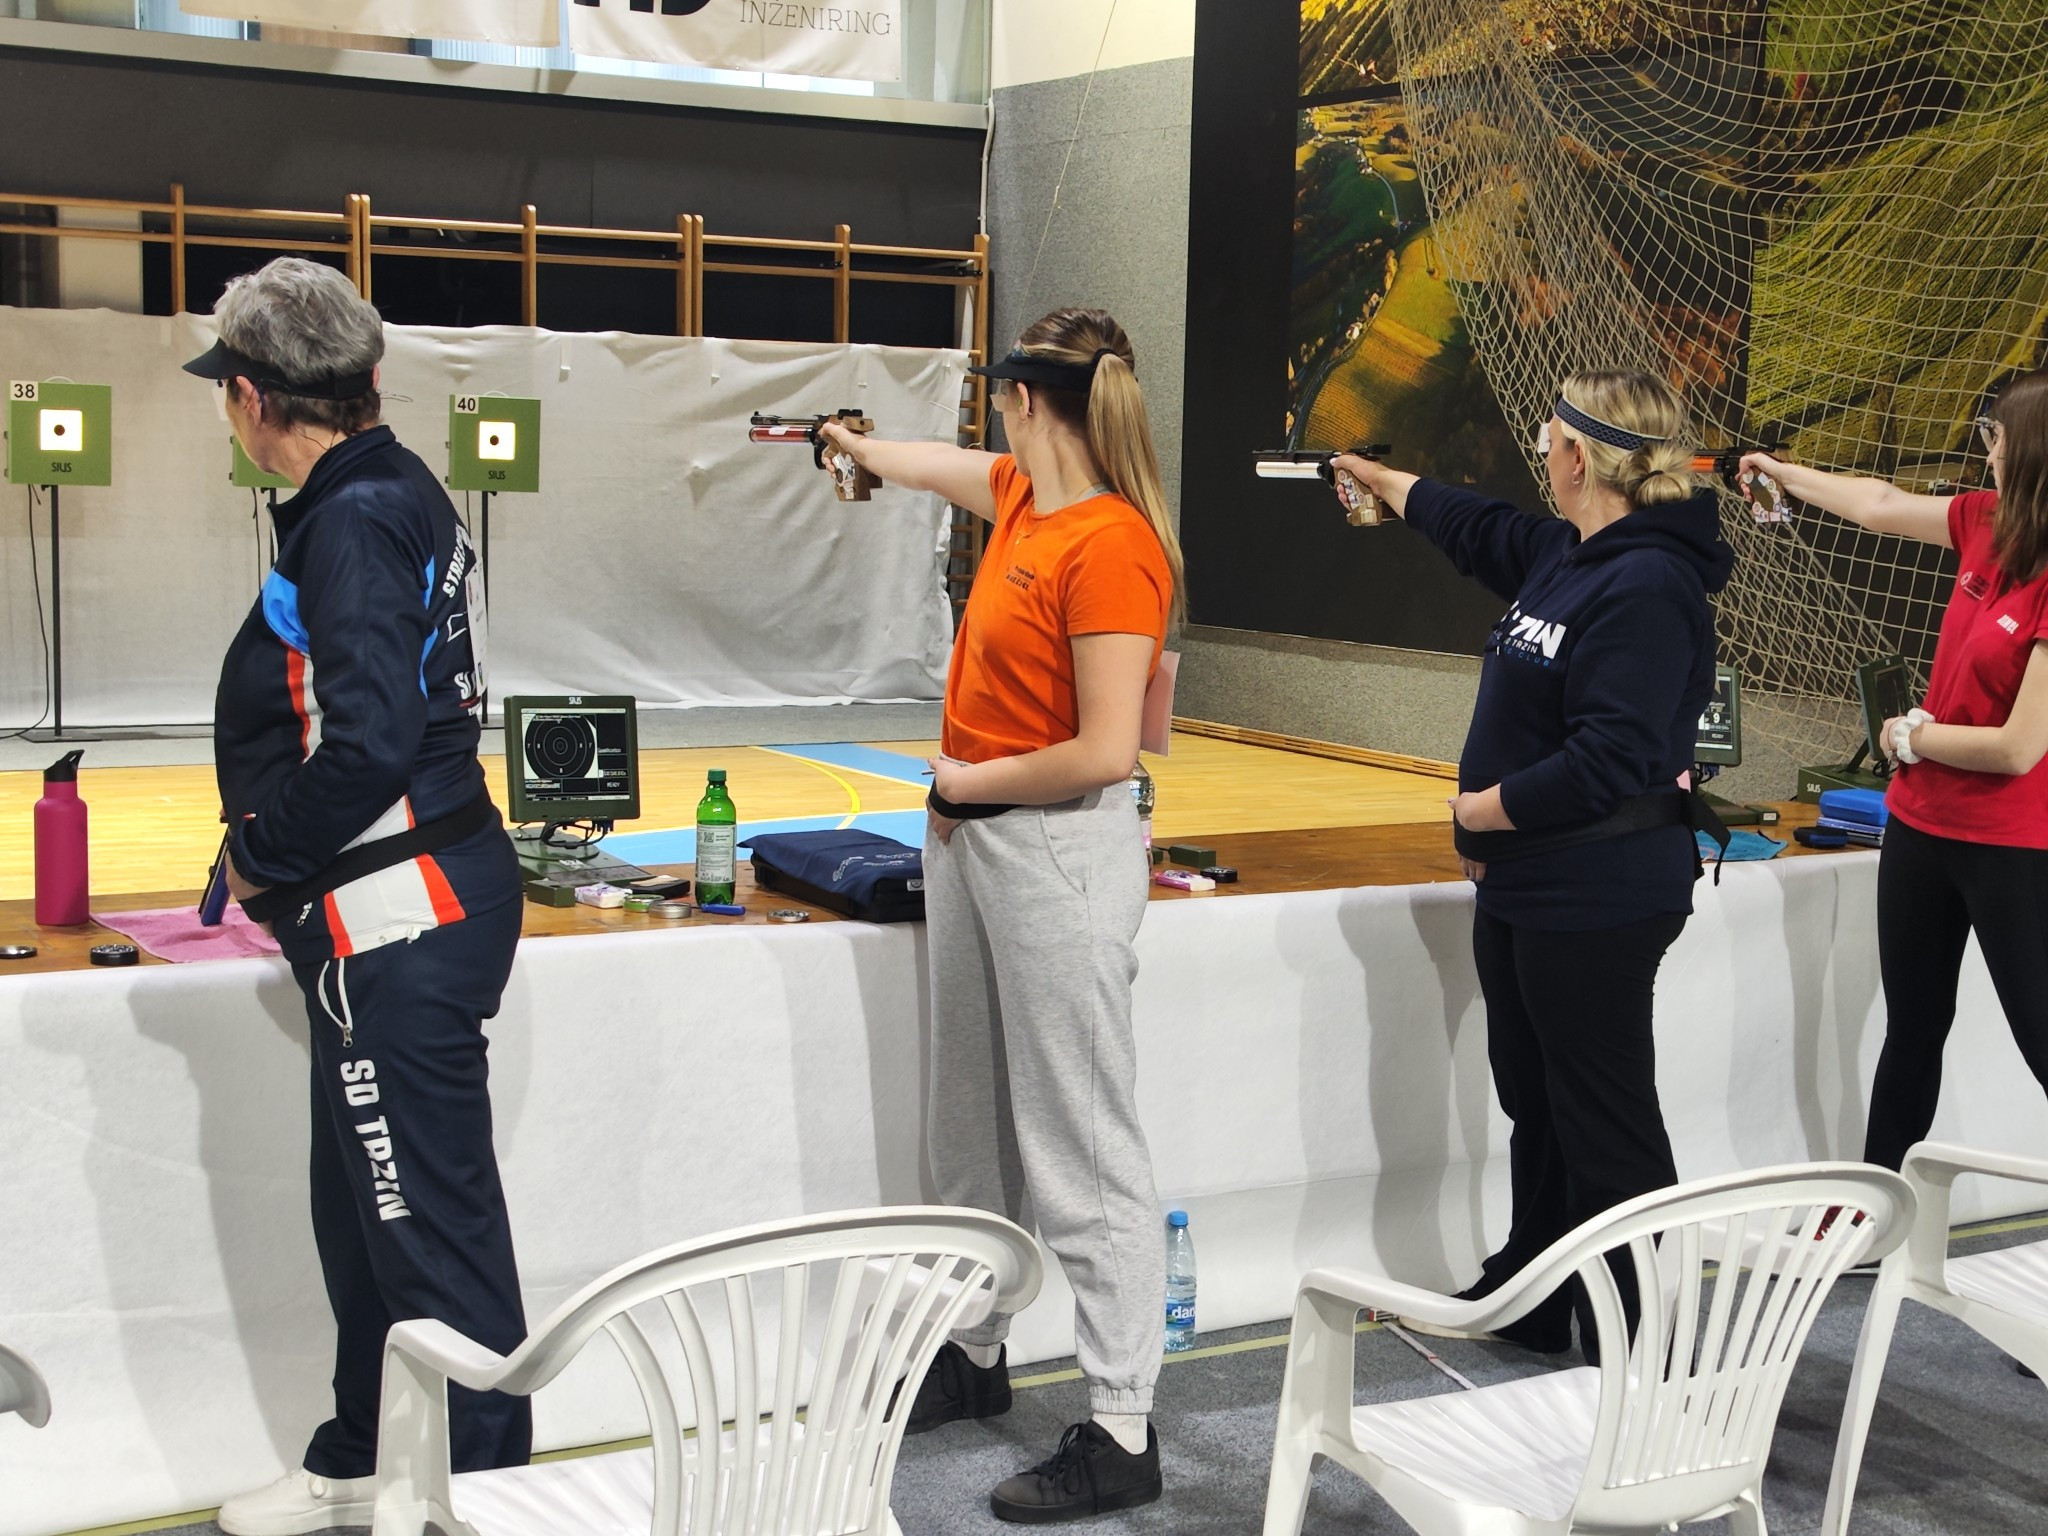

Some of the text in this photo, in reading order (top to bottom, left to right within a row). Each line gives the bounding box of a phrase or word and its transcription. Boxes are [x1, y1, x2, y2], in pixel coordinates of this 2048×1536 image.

[14, 383, 35, 399] 38
[457, 397, 476, 412] 40
[51, 461, 72, 473] SIUS
[488, 470, 506, 480] SIUS
[1512, 639, 1539, 654] TRZIN
[1518, 651, 1550, 668] CLUB
[568, 696, 583, 705] SIUS
[1712, 712, 1721, 724] 9
[1806, 782, 1821, 794] SIUS
[340, 1059, 380, 1106] SD
[355, 1115, 412, 1221] TRZIN
